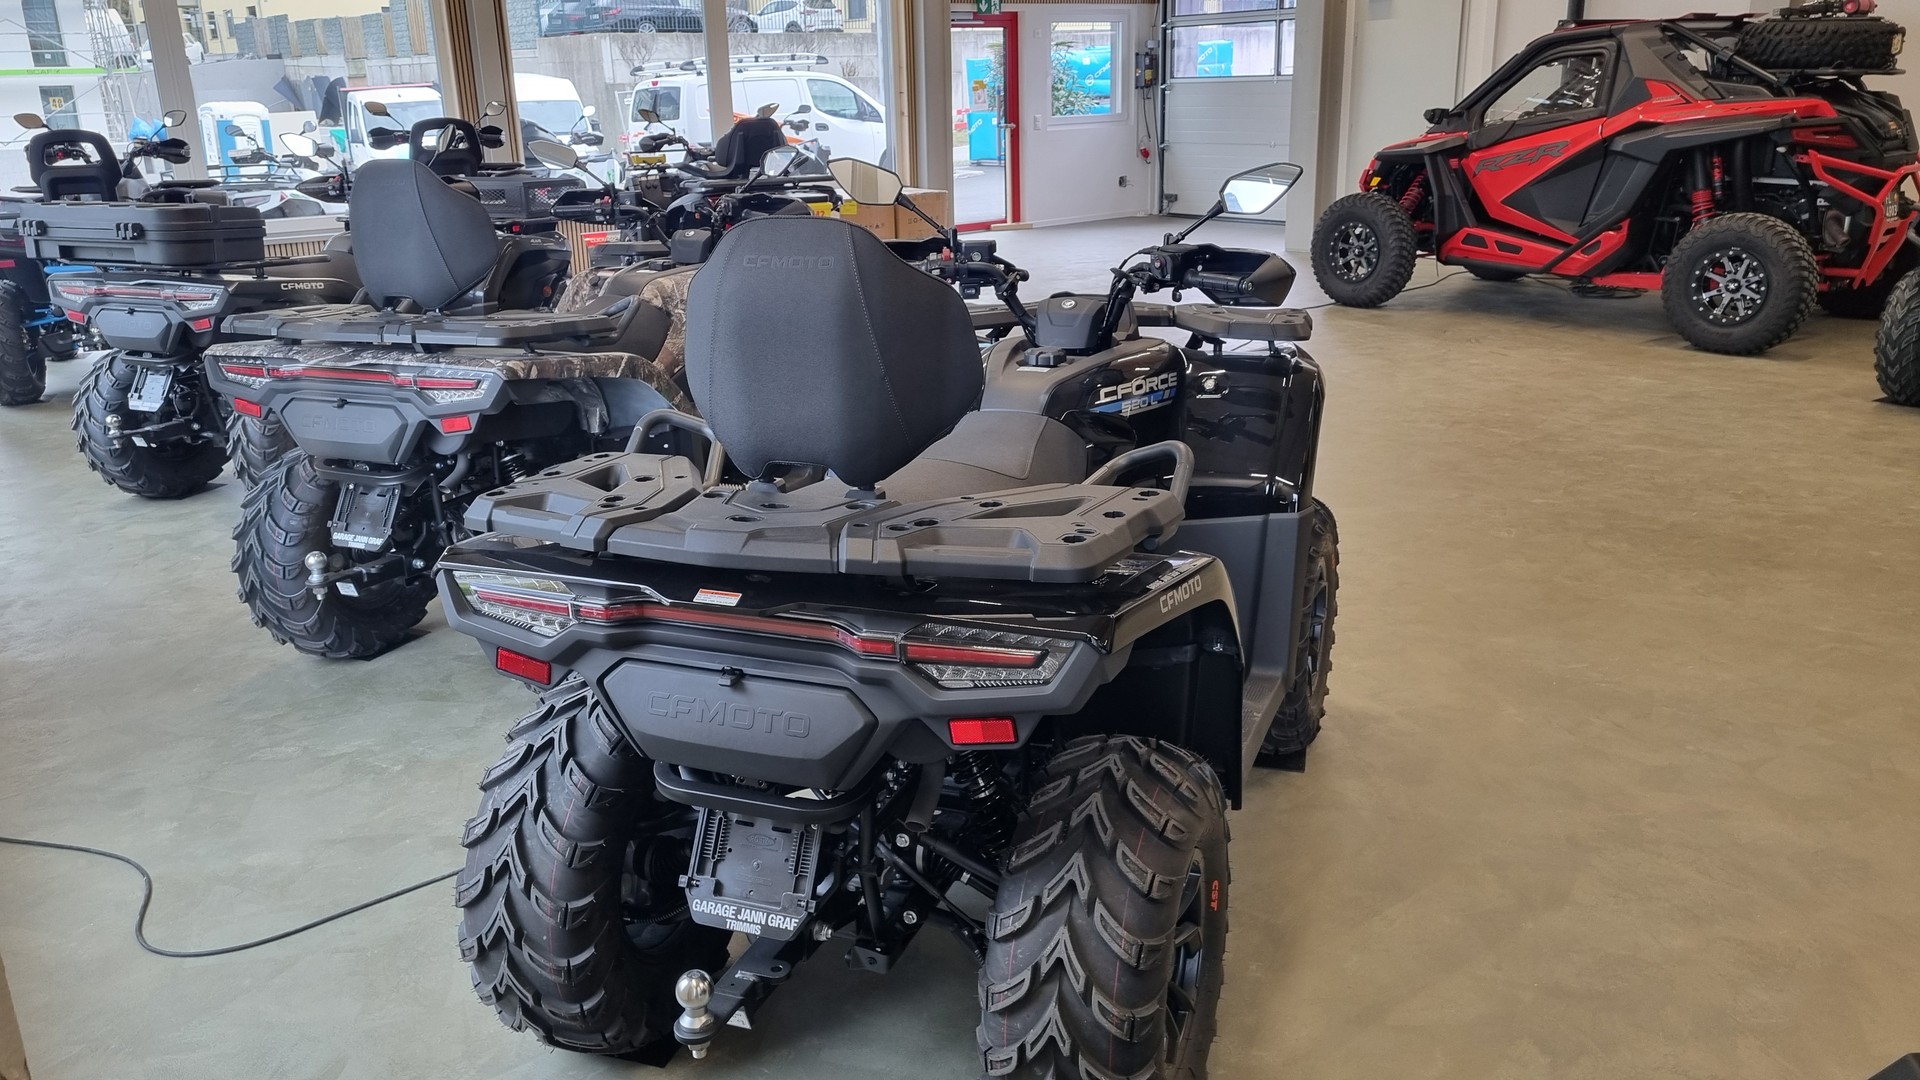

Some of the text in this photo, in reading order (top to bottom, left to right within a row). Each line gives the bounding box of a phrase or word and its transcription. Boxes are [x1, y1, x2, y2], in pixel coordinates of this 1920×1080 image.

[1472, 140, 1571, 178] RZR
[743, 254, 834, 269] CFMOTO
[280, 282, 325, 290] CFMOTO
[1095, 371, 1178, 404] CFORCE
[1160, 574, 1202, 613] CFMOTO
[648, 690, 811, 739] CFMOTO
[1210, 880, 1219, 911] CST
[692, 899, 800, 931] GARAGE JANN GRAF
[725, 918, 762, 936] TRIMMIS
